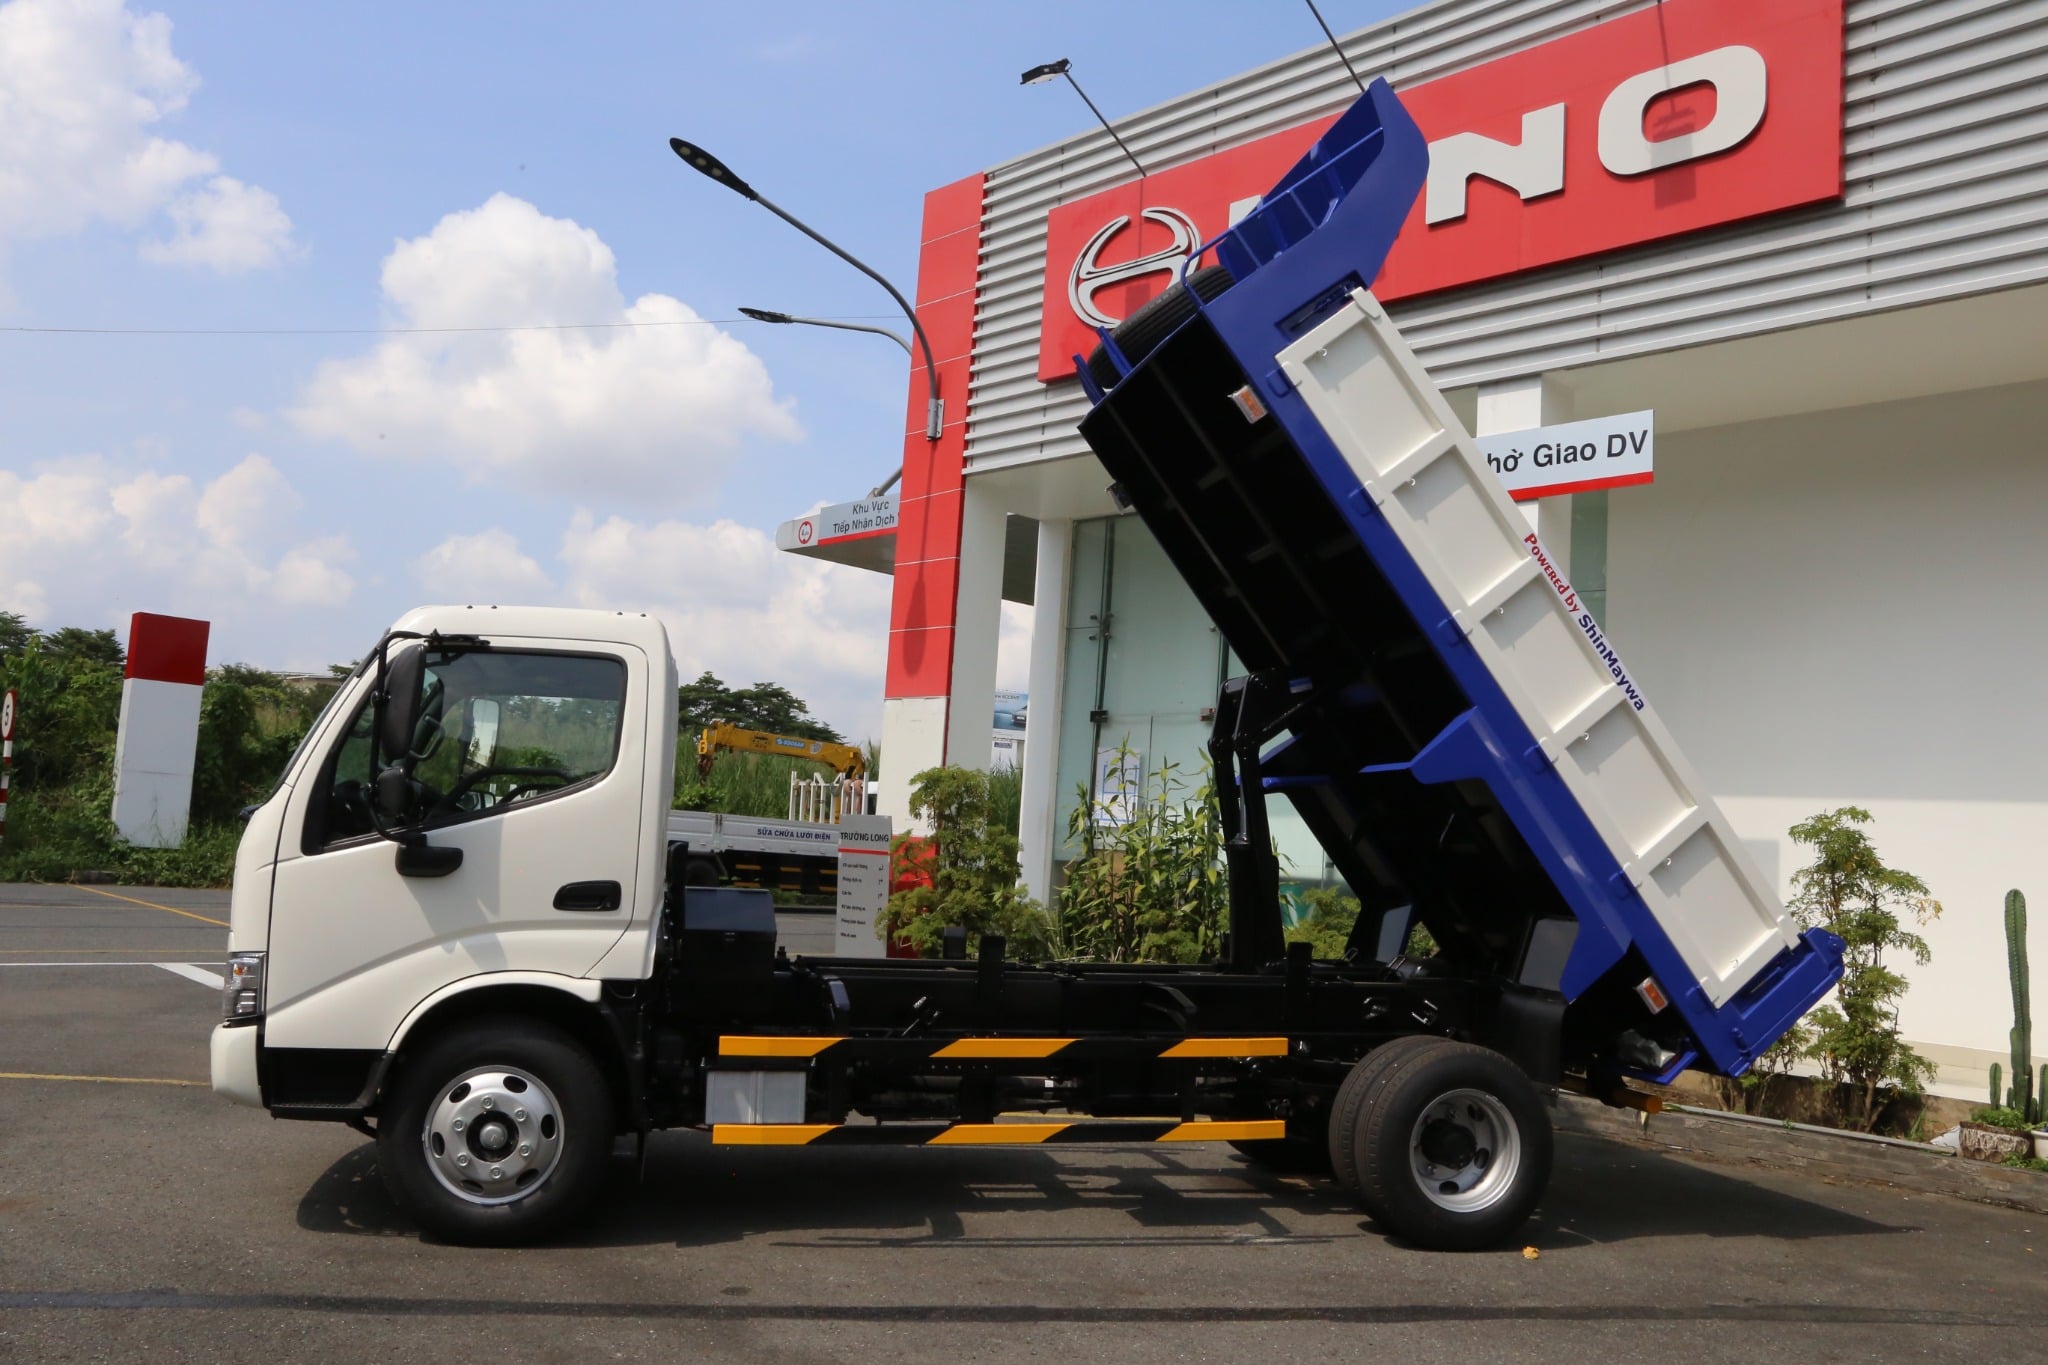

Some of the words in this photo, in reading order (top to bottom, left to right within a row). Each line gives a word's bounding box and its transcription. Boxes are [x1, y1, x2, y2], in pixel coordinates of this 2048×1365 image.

[1487, 447, 1524, 474] hờ
[1533, 441, 1597, 468] Giao
[1606, 429, 1649, 458] DV
[853, 504, 869, 515] Khu
[871, 501, 889, 514] Vực
[833, 519, 850, 534] Tiếp
[851, 517, 873, 530] Nhận
[875, 513, 895, 527] Dịch
[1564, 593, 1580, 613] by
[1578, 614, 1645, 711] ShinMaywa
[5, 704, 10, 726] 5
[870, 832, 889, 843] LONG
